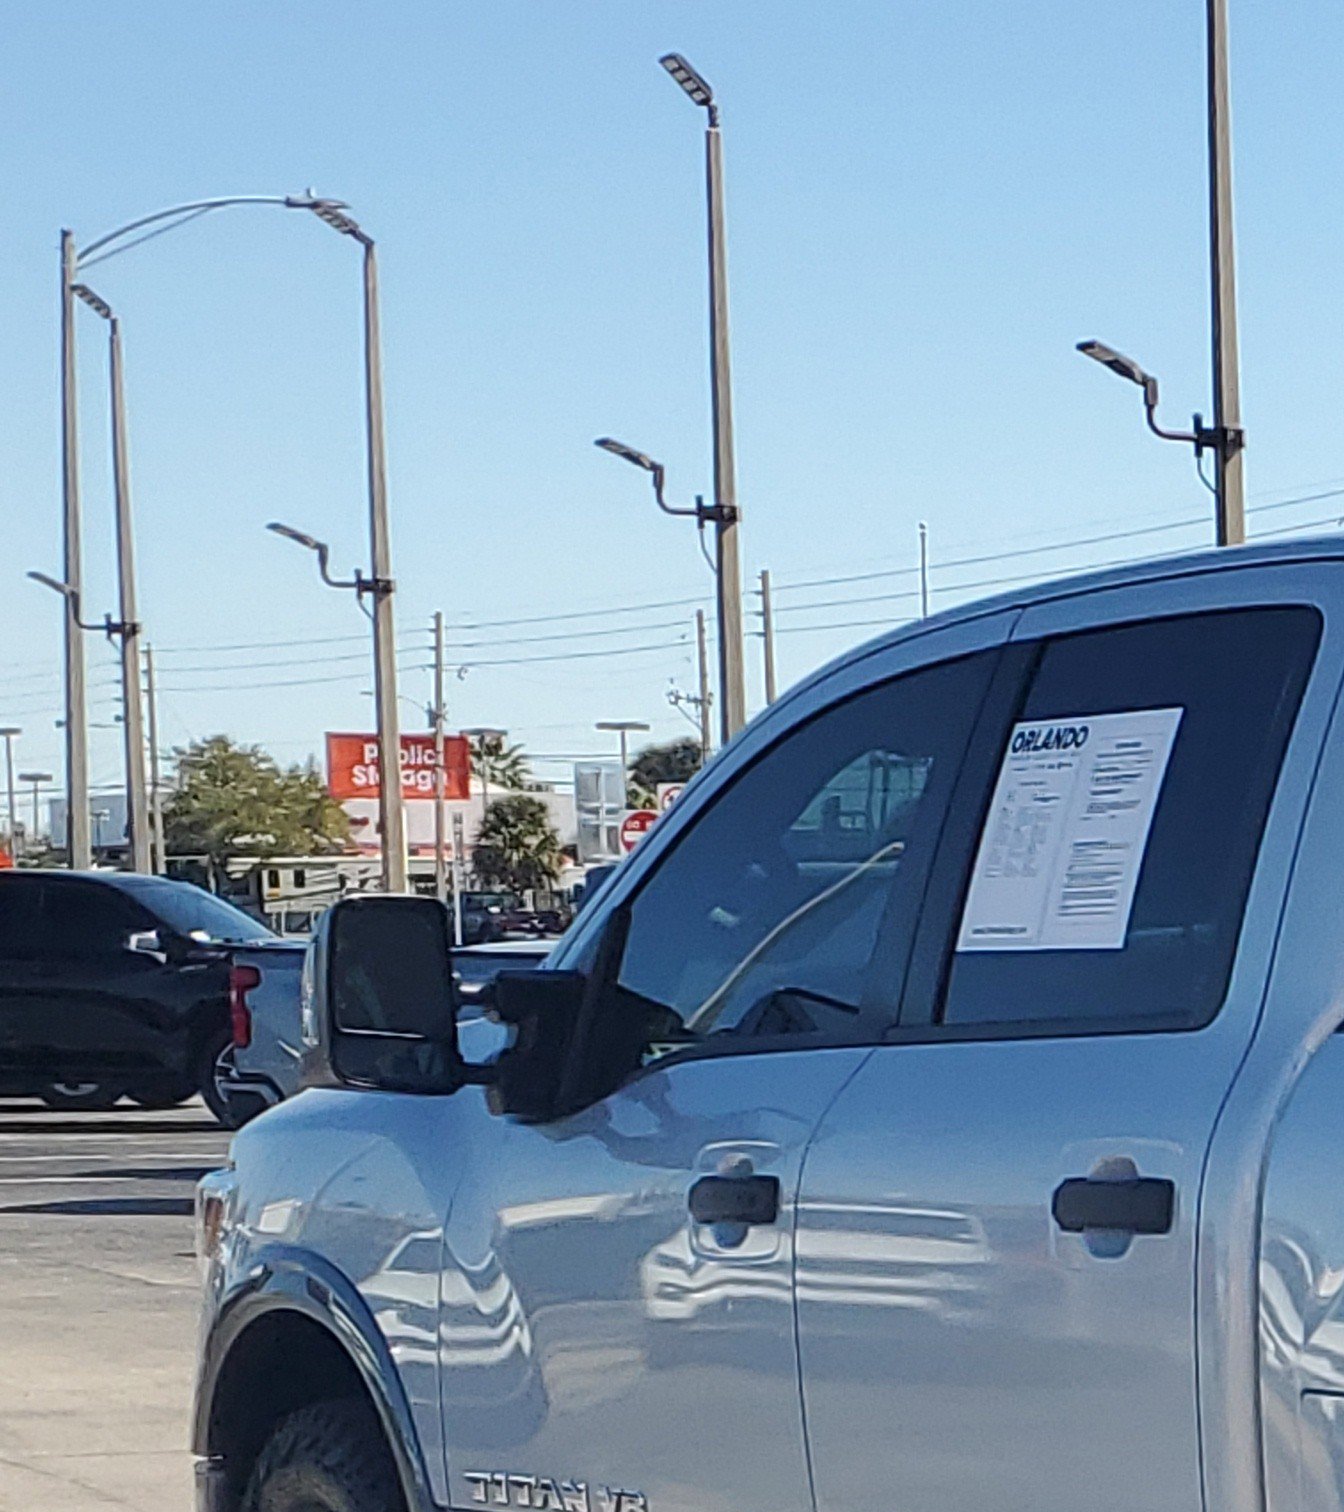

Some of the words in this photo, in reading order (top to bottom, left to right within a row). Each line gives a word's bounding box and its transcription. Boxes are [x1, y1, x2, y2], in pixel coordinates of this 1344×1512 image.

[1011, 725, 1089, 753] ORLANDO
[363, 743, 437, 764] Plic
[352, 764, 448, 791] Stag
